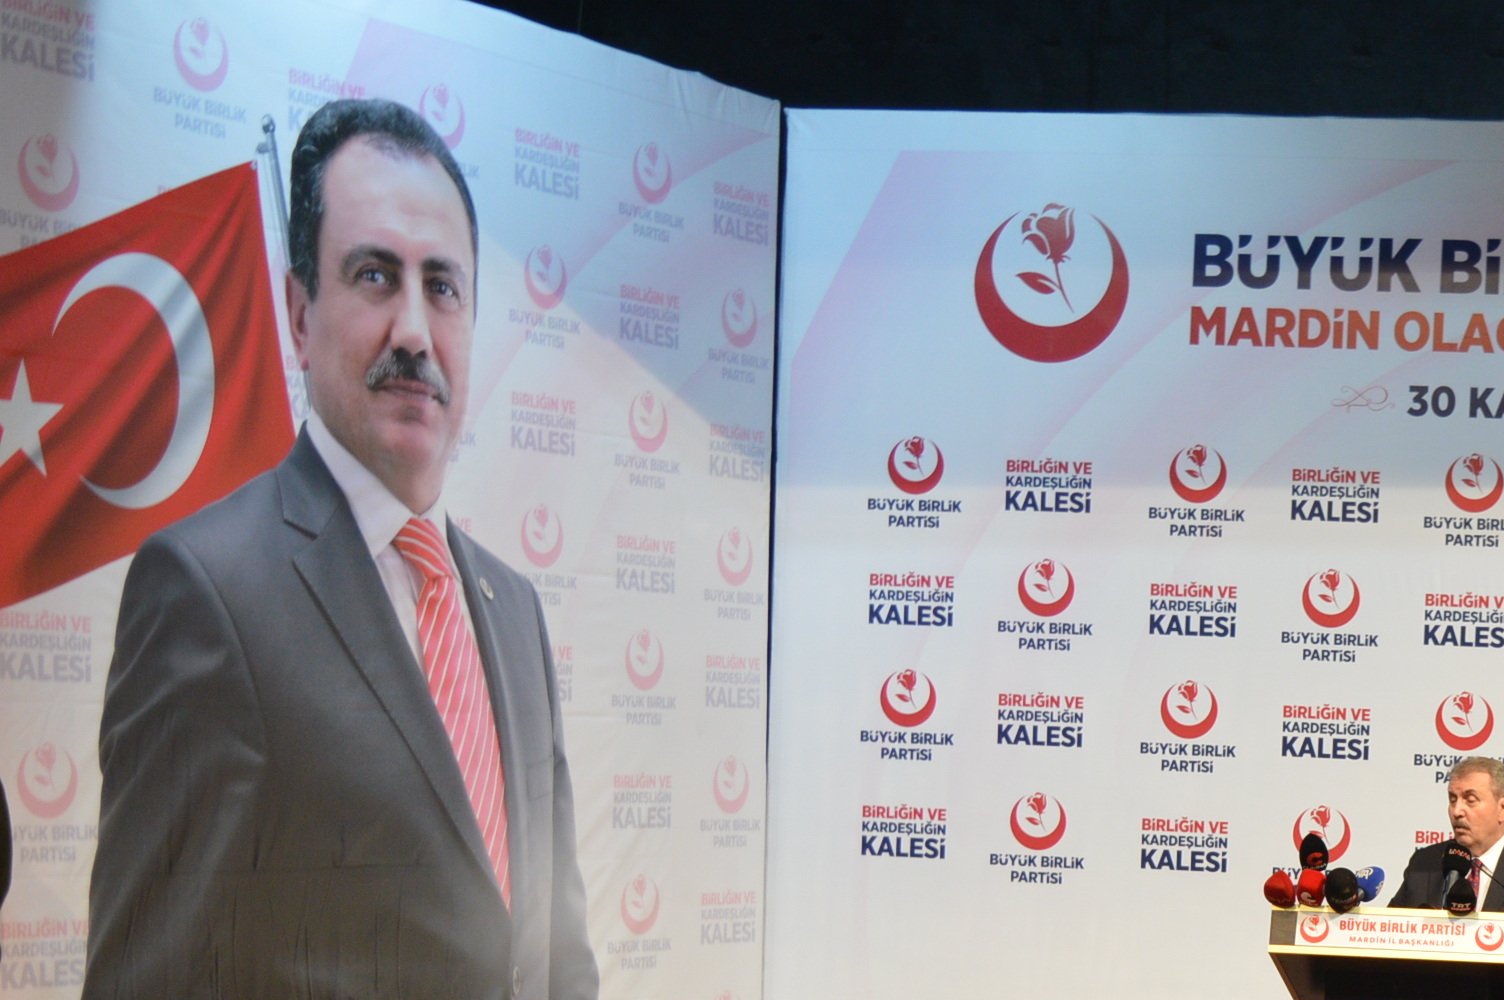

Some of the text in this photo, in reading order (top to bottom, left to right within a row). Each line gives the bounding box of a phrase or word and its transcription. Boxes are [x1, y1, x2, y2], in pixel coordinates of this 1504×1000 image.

[1192, 233, 1423, 293] BÜYÜK
[1189, 305, 1380, 350] MARDİN
[1406, 385, 1456, 418] 30
[1006, 457, 1093, 475] BİRLİĞİN VE
[1291, 466, 1381, 485] BİRLİĞİN VE
[867, 497, 962, 513] BÜYÜK BİRLİK
[1004, 489, 1092, 514] KALESİ
[1290, 498, 1380, 524] KALESİ
[887, 514, 940, 529] PARTİSİ
[1423, 515, 1474, 531] BÜYÜK
[1444, 533, 1500, 548] PARTİSİ
[869, 571, 955, 589] BİRLİĞİN VE
[1424, 591, 1490, 609] BİRLİĞİN
[868, 602, 954, 628] KALESİ
[1280, 630, 1379, 648] BÜYÜK BİRLİK
[1302, 648, 1356, 663] PARTİSİ
[997, 691, 1085, 711] BİRLİĞİN VE
[996, 723, 1084, 749] KALESİ
[1139, 741, 1237, 759] BÜYÜK BİRLİK
[1160, 758, 1214, 774] PARTİSİ
[861, 803, 947, 822] BİRLİĞİN VE
[860, 834, 946, 860] KALESİ
[989, 852, 1085, 870] BÜYÜK BİRLİK
[1010, 869, 1063, 885] PARTİSİ
[1339, 918, 1466, 936] BÜYÜK BİRLİK PARTİSİ
